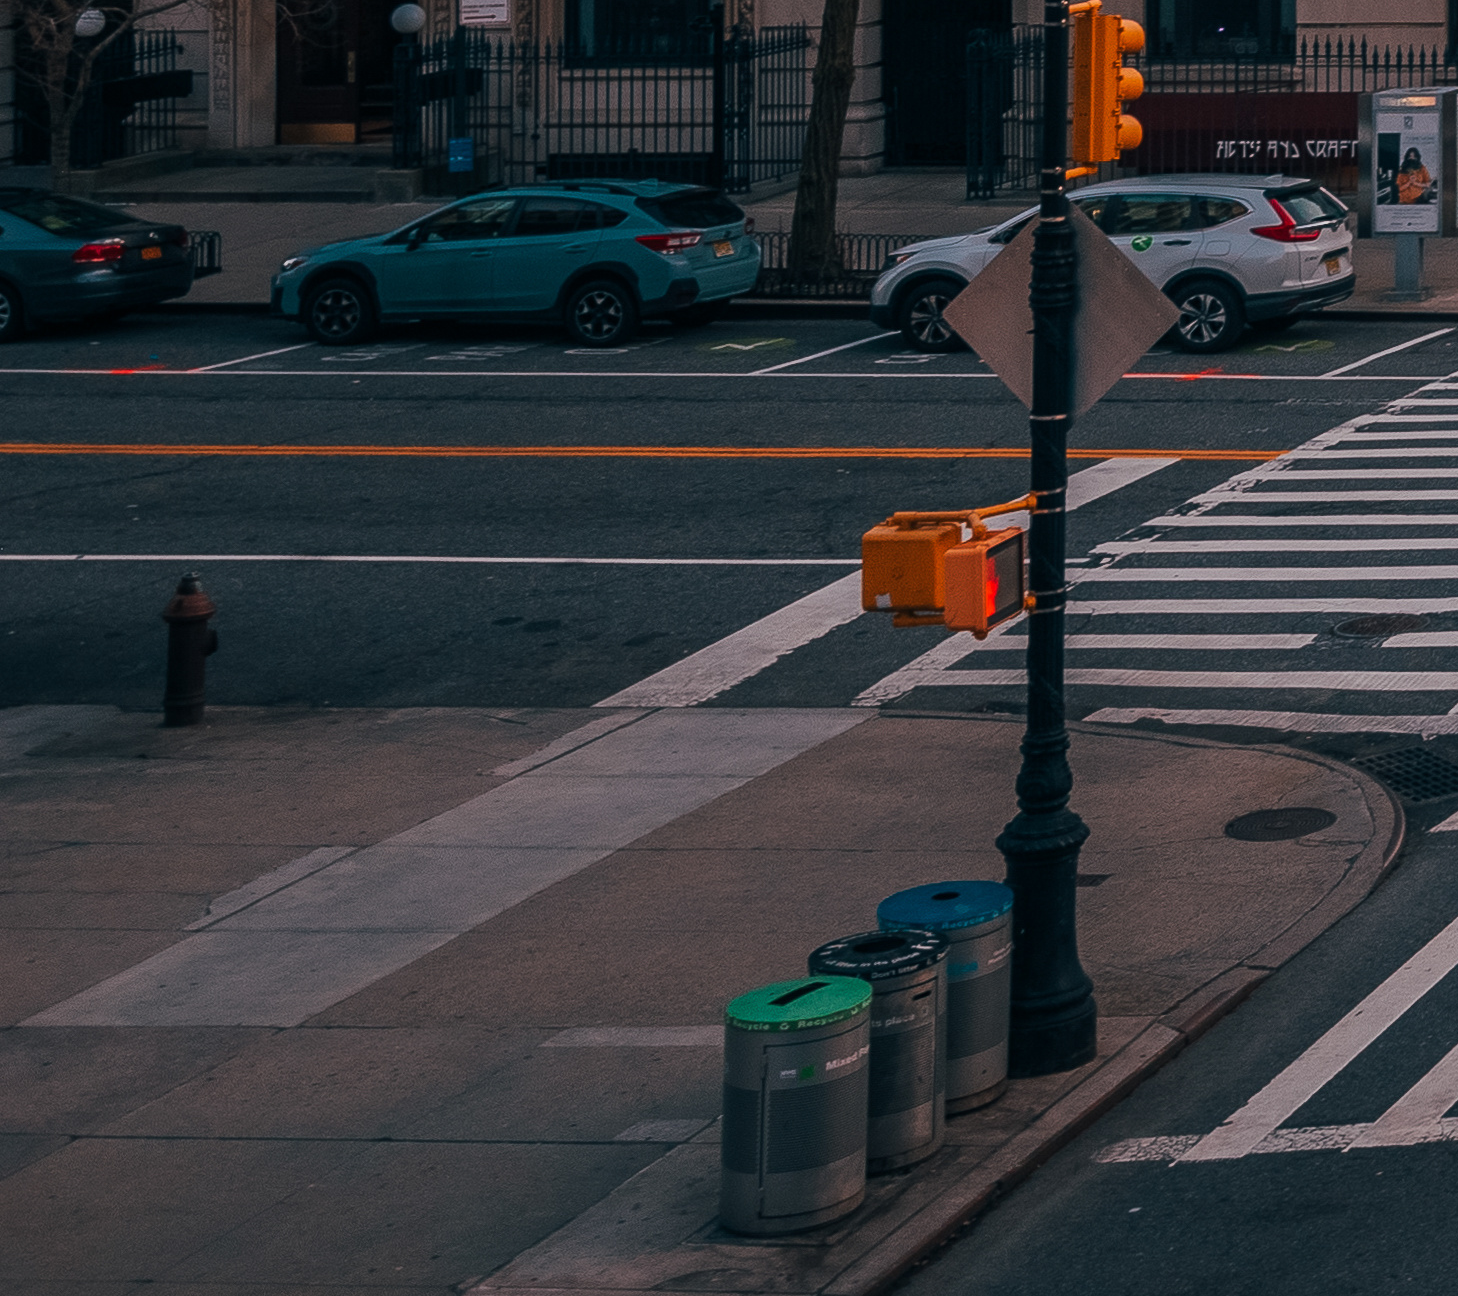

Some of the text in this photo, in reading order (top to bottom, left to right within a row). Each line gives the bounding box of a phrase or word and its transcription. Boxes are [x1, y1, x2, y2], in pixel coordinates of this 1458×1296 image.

[1216, 140, 1359, 159] ARTS AND CRAFT
[871, 968, 897, 980] Don't
[885, 1014, 916, 1028] place
[825, 1051, 858, 1071] Mixed
